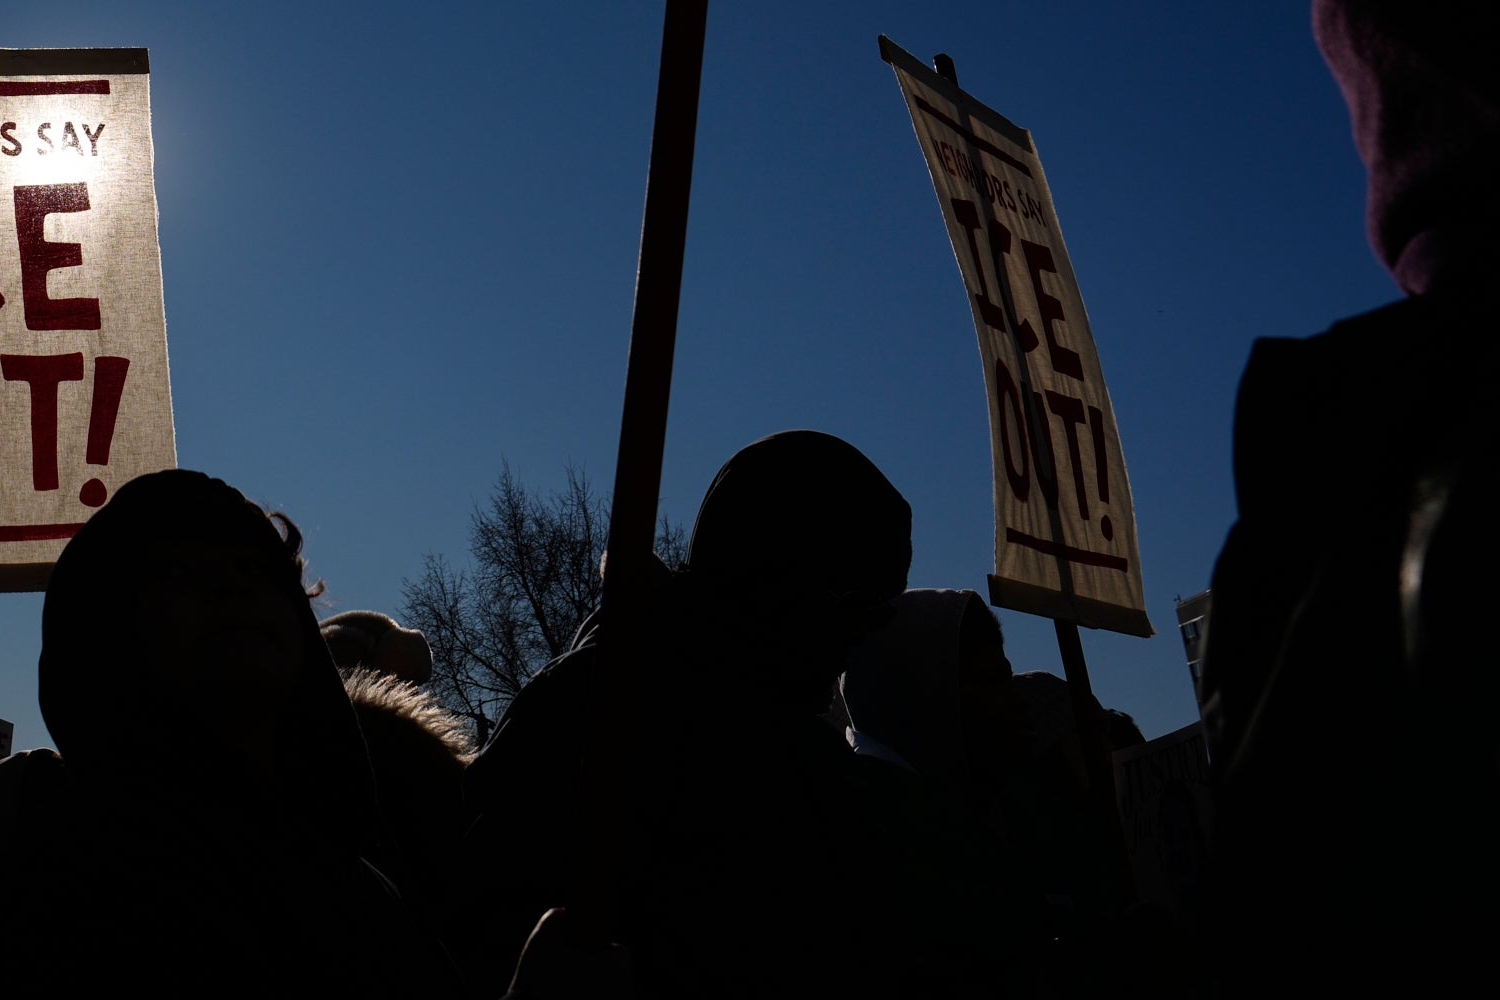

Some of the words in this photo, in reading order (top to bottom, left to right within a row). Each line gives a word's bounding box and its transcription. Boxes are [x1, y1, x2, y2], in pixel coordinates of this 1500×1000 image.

[35, 120, 106, 159] SAY
[1017, 188, 1047, 228] SAY
[951, 197, 1084, 382] ICE
[996, 357, 1113, 542] OUT!
